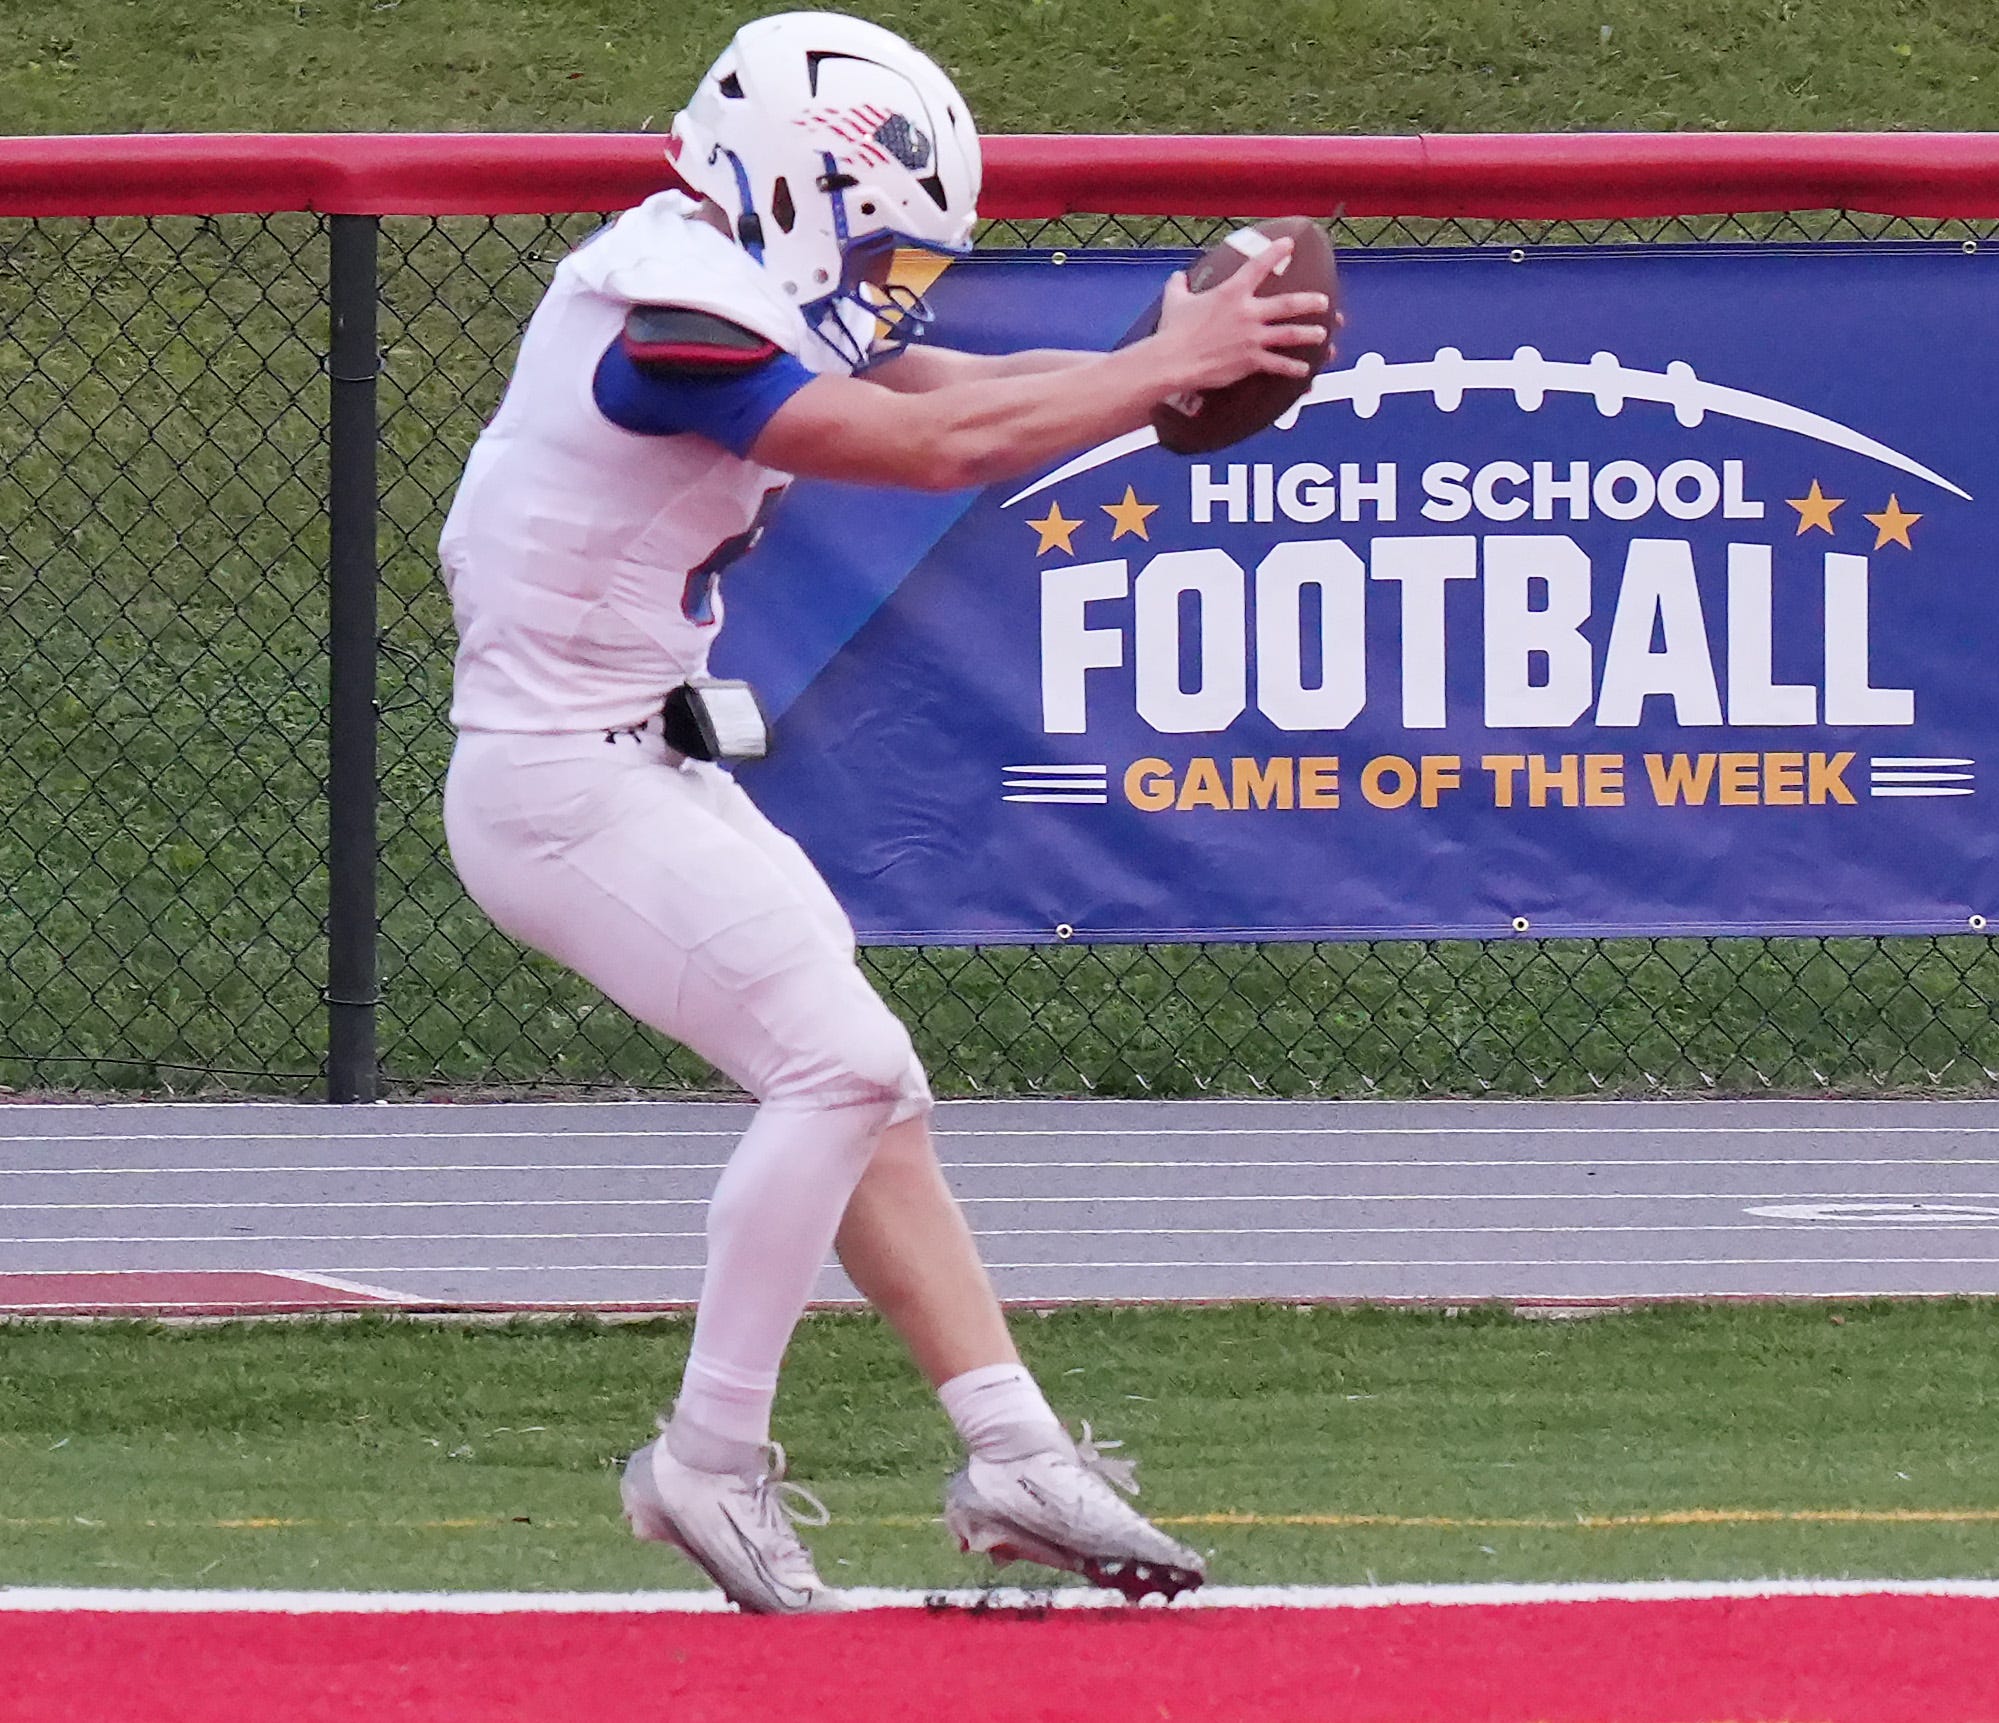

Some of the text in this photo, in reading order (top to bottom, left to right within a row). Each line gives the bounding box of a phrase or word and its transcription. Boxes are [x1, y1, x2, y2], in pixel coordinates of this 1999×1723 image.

[1191, 460, 1764, 522] HIGH SCHOOL
[1041, 535, 1914, 733] FOOTBALL
[1125, 752, 1856, 811] GAME OF THE WEEK
